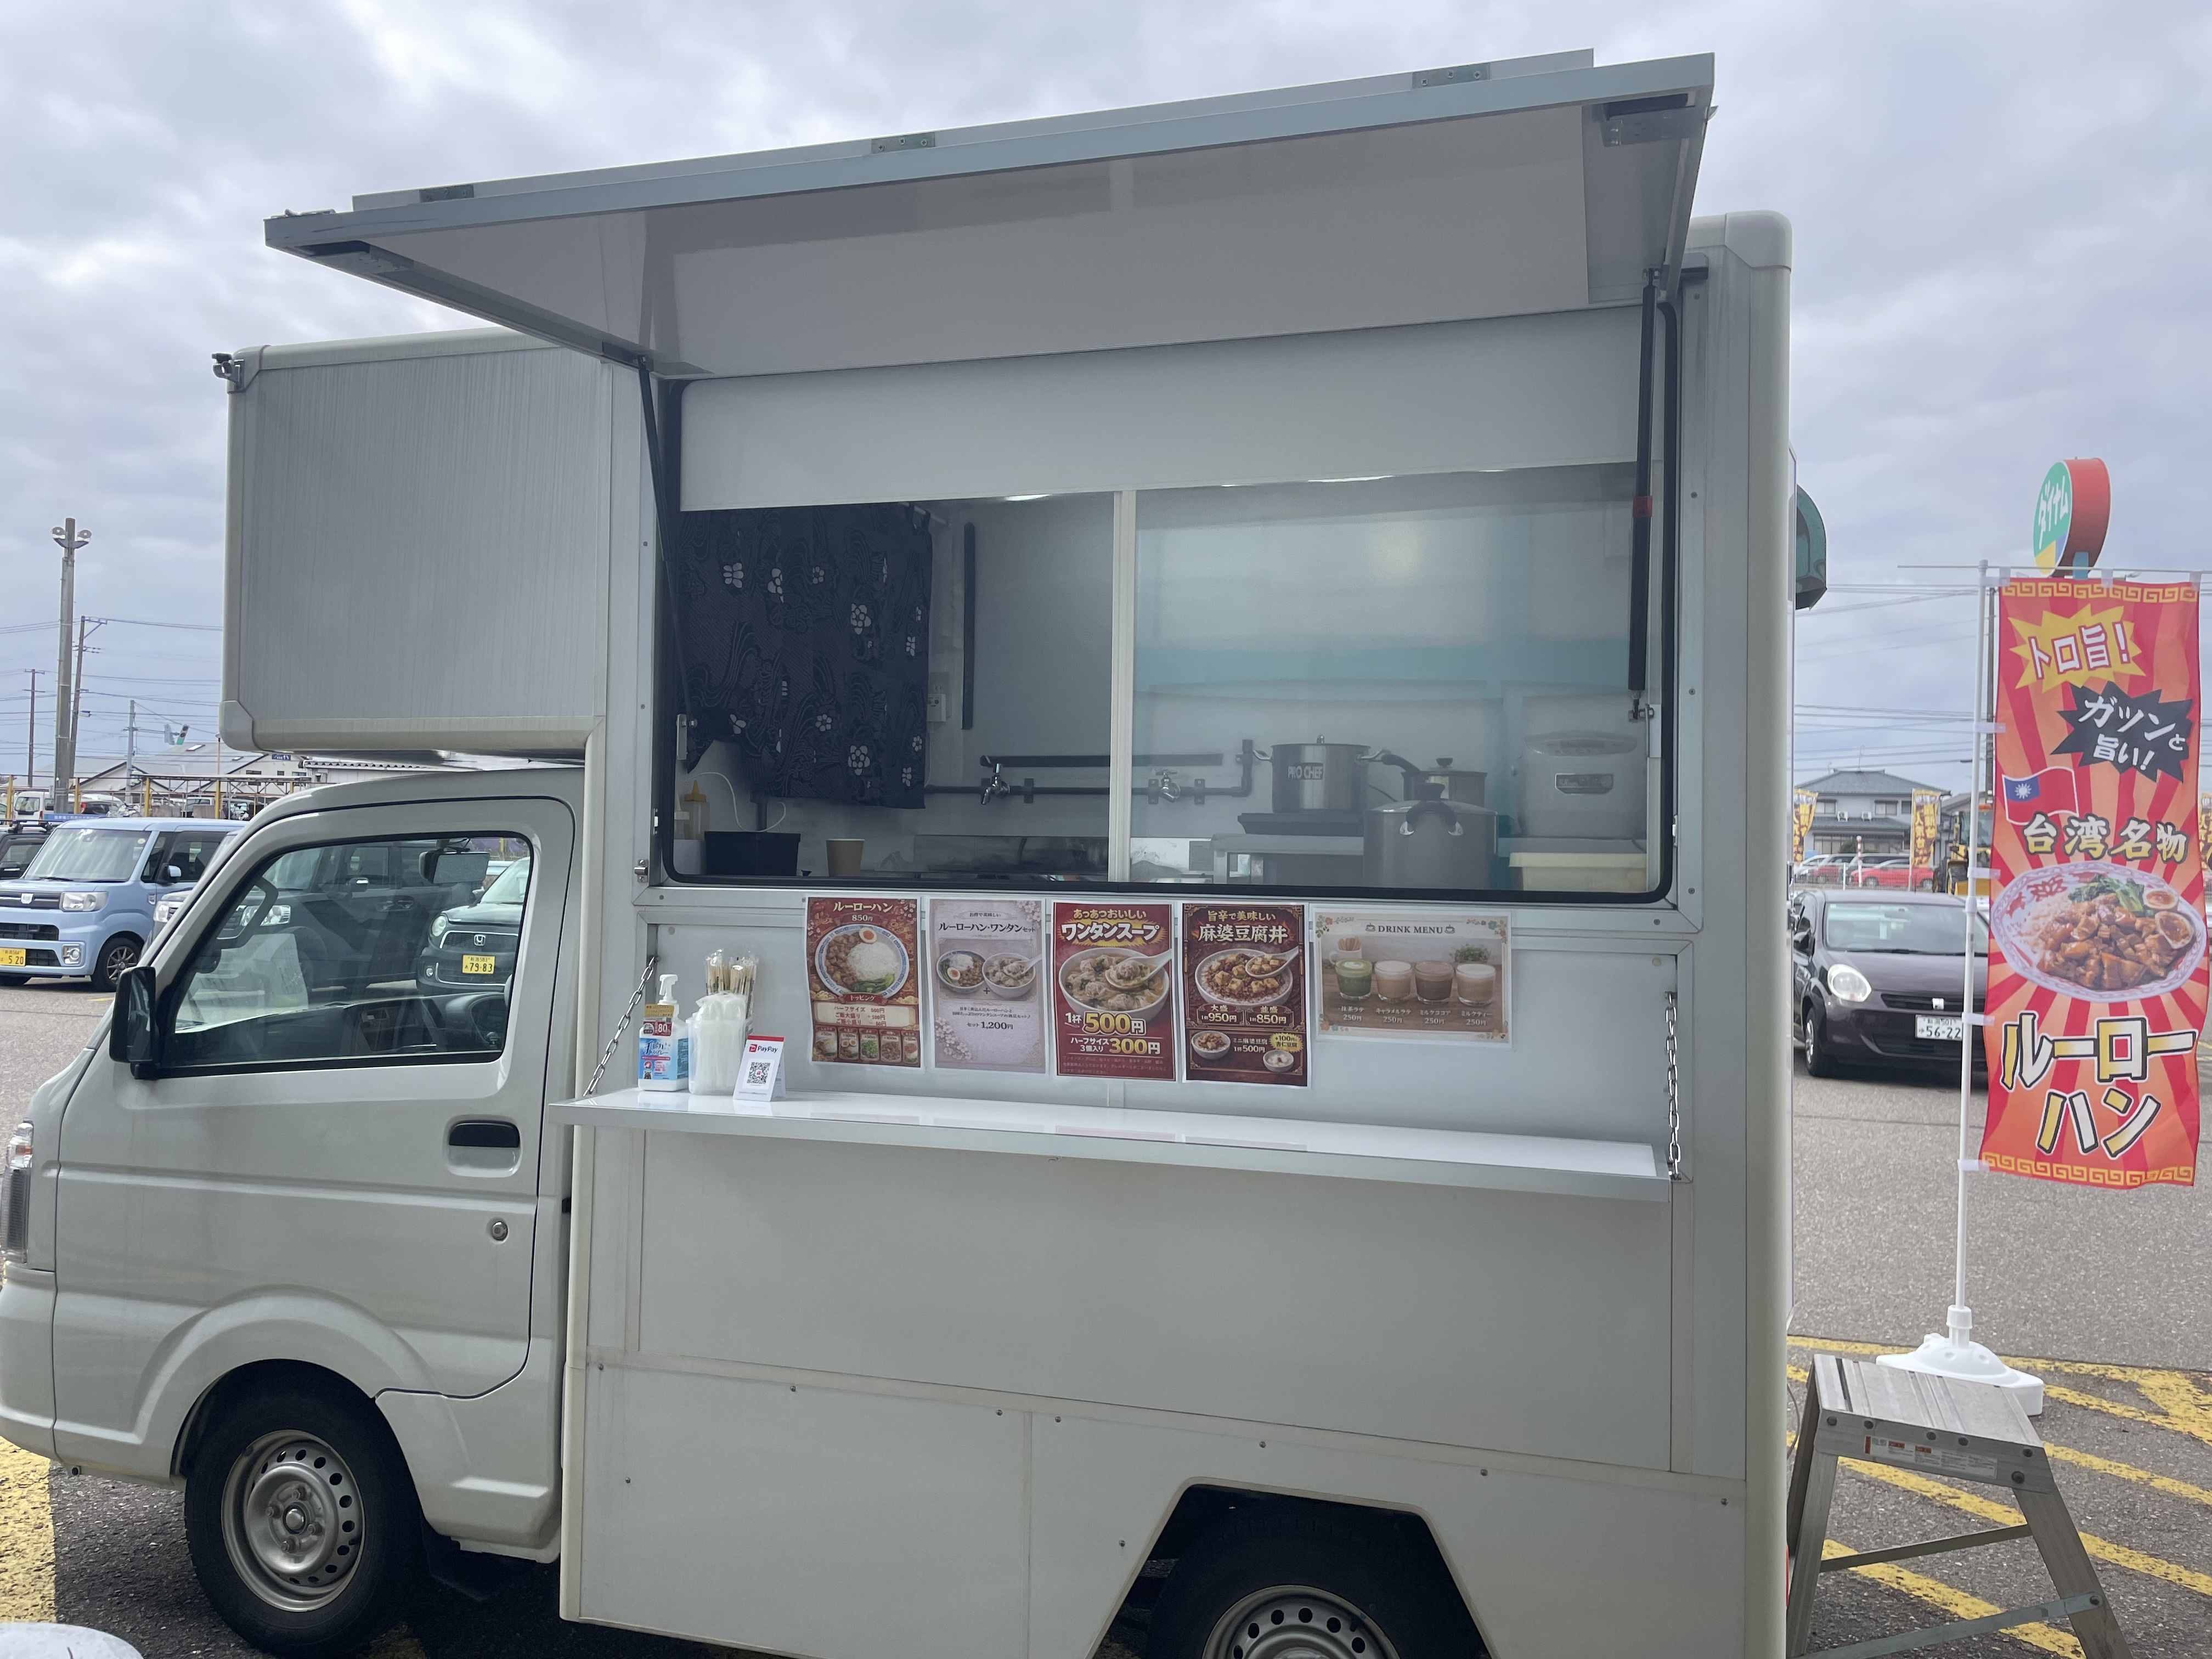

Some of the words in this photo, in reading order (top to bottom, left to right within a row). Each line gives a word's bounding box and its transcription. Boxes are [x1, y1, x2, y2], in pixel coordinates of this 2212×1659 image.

[2038, 475, 2068, 550] ダイナム
[2078, 696, 2186, 751] ガツンと
[1288, 765, 1302, 778] PRO
[1304, 766, 1323, 778] CHEF
[2023, 812, 2187, 862] 台湾名物
[833, 901, 894, 913] ルーローハン
[1208, 910, 1276, 922] 旨辛で美味しい
[1061, 922, 1160, 941] ワンタンスープ
[1198, 924, 1288, 944] 麻婆豆腐丼
[981, 1021, 1013, 1030] 1,200円
[1065, 1013, 1082, 1024] 1杯
[1084, 1012, 1144, 1034] 500円
[758, 1045, 778, 1053] PayPay
[1109, 1038, 1160, 1054] 300円
[2001, 1012, 2197, 1091] ルーロー
[2036, 1087, 2162, 1159] ハン
